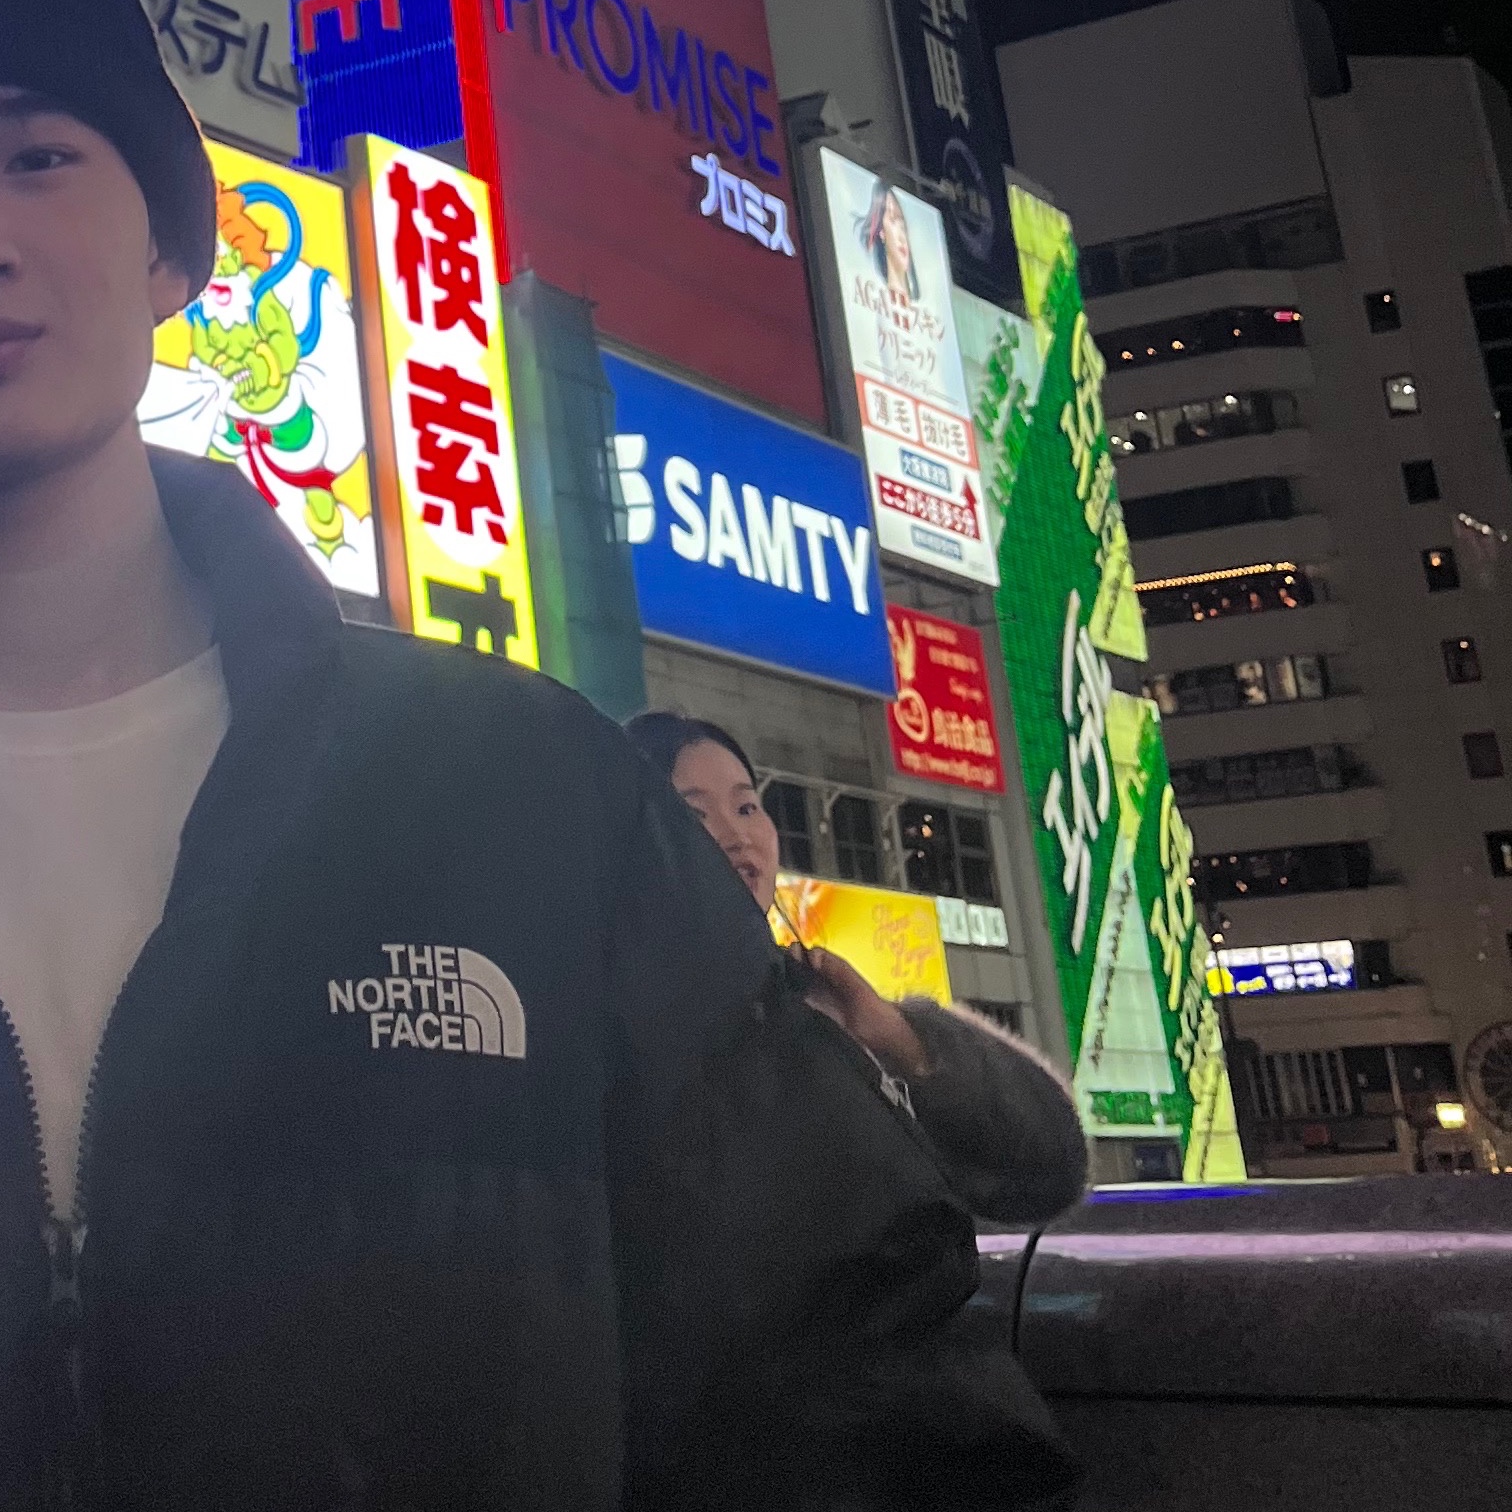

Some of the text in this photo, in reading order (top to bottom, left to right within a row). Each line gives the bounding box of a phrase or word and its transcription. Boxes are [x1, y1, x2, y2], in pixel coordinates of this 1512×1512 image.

[690, 152, 796, 257] プロミス
[852, 274, 890, 319] AGA
[387, 160, 509, 546] 検索
[877, 329, 937, 377] クリニック
[664, 455, 871, 616] SAMTY
[381, 943, 459, 979] THE
[328, 978, 462, 1014] NORTH
[369, 1011, 464, 1050] FACE
